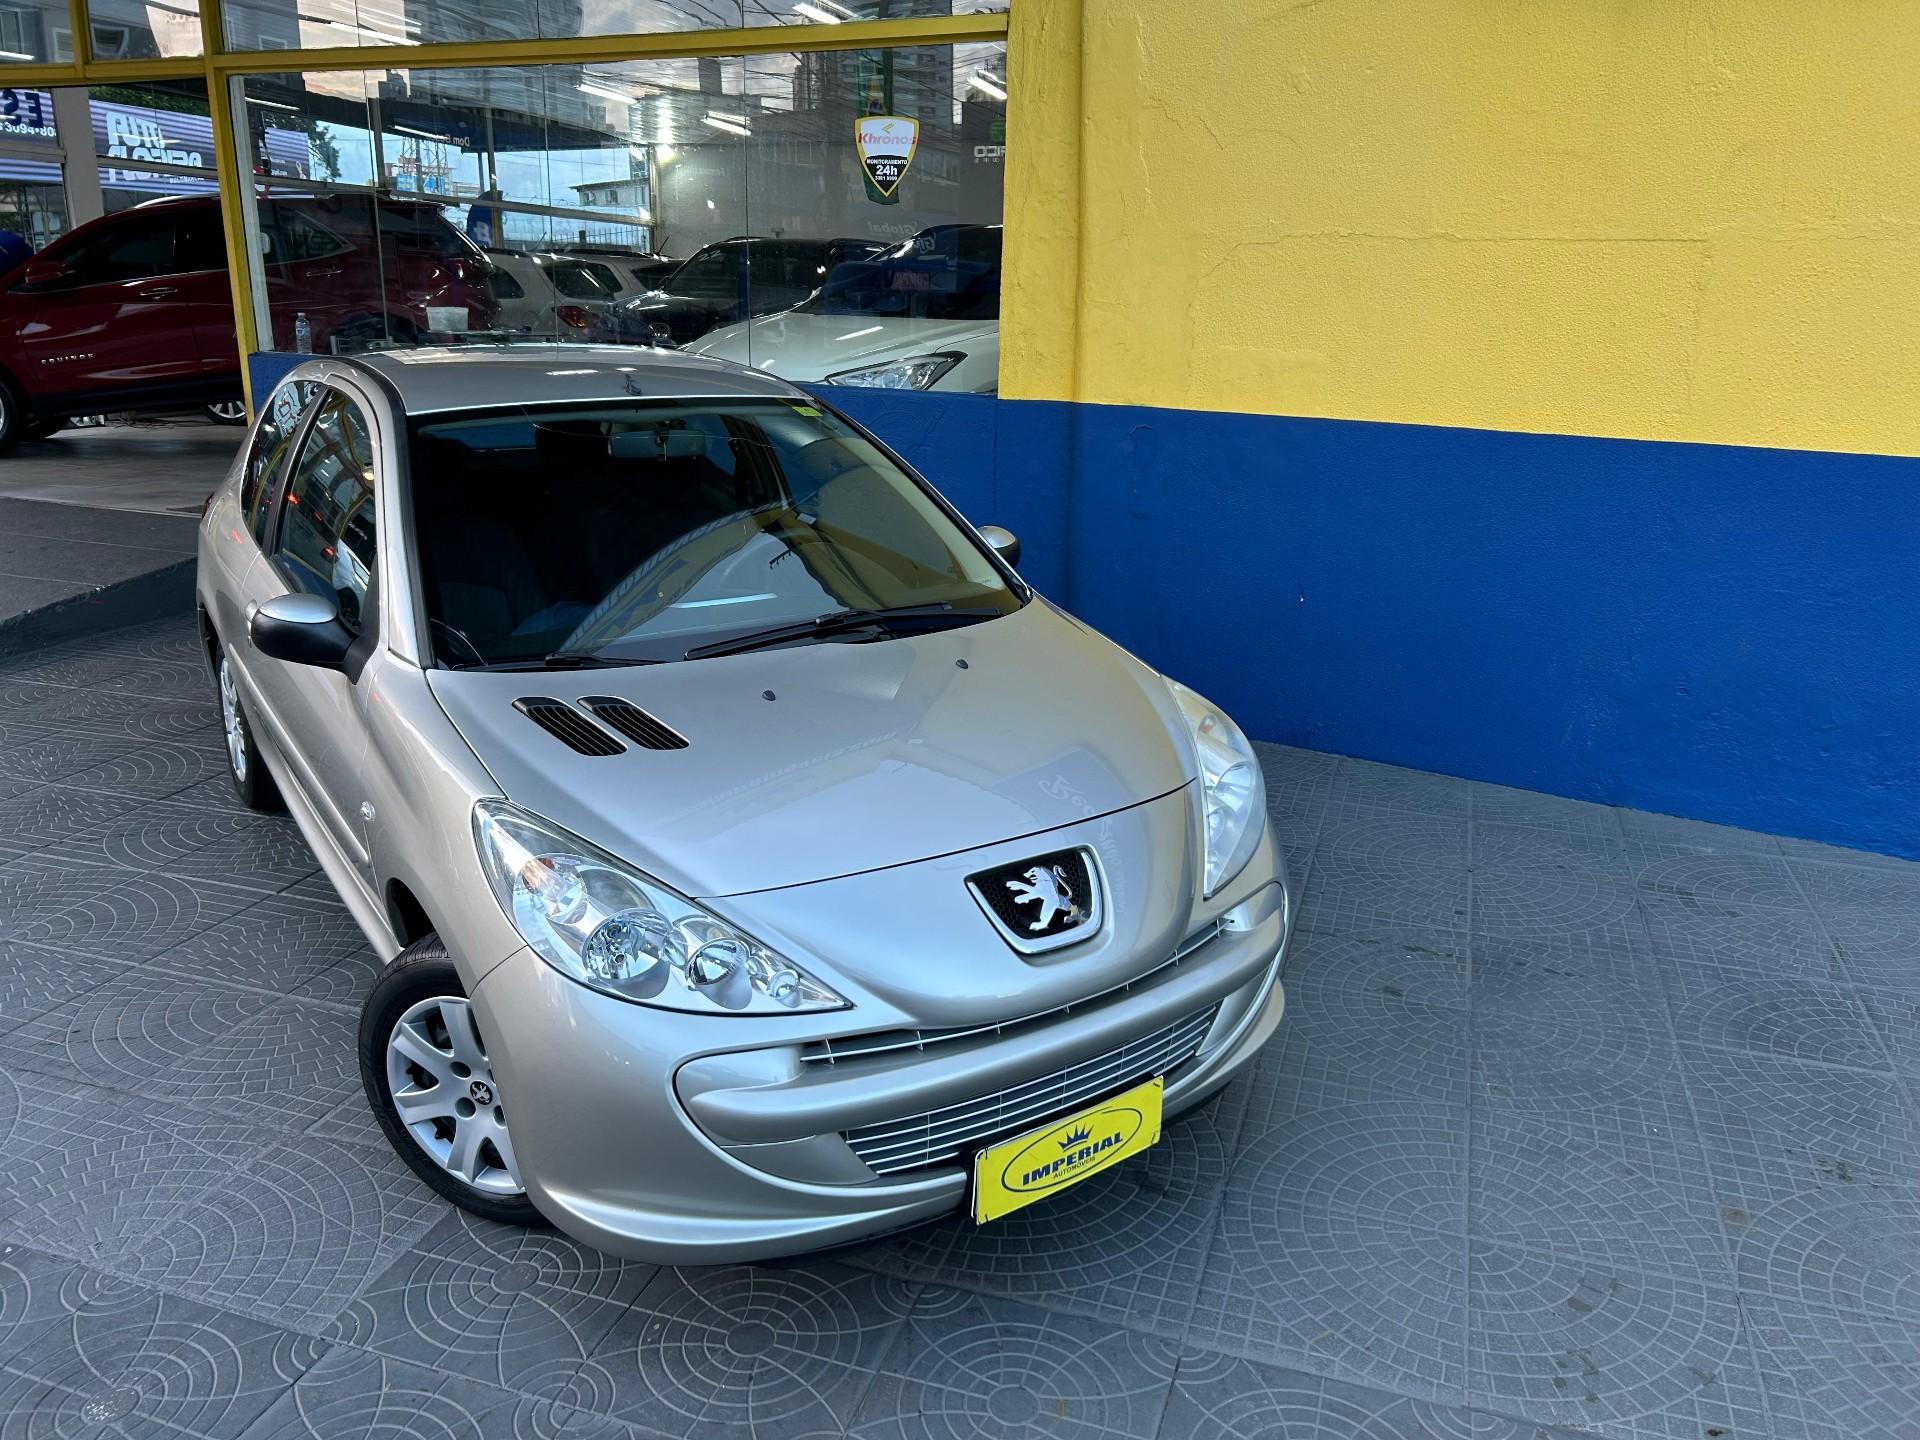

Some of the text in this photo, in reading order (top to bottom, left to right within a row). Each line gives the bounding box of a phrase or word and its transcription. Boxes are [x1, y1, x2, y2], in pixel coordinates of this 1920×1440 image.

[858, 132, 917, 144] Khronos
[866, 158, 908, 166] MONITORAMENTO
[876, 165, 898, 176] 24h
[1022, 1131, 1124, 1186] IMPERIAL
